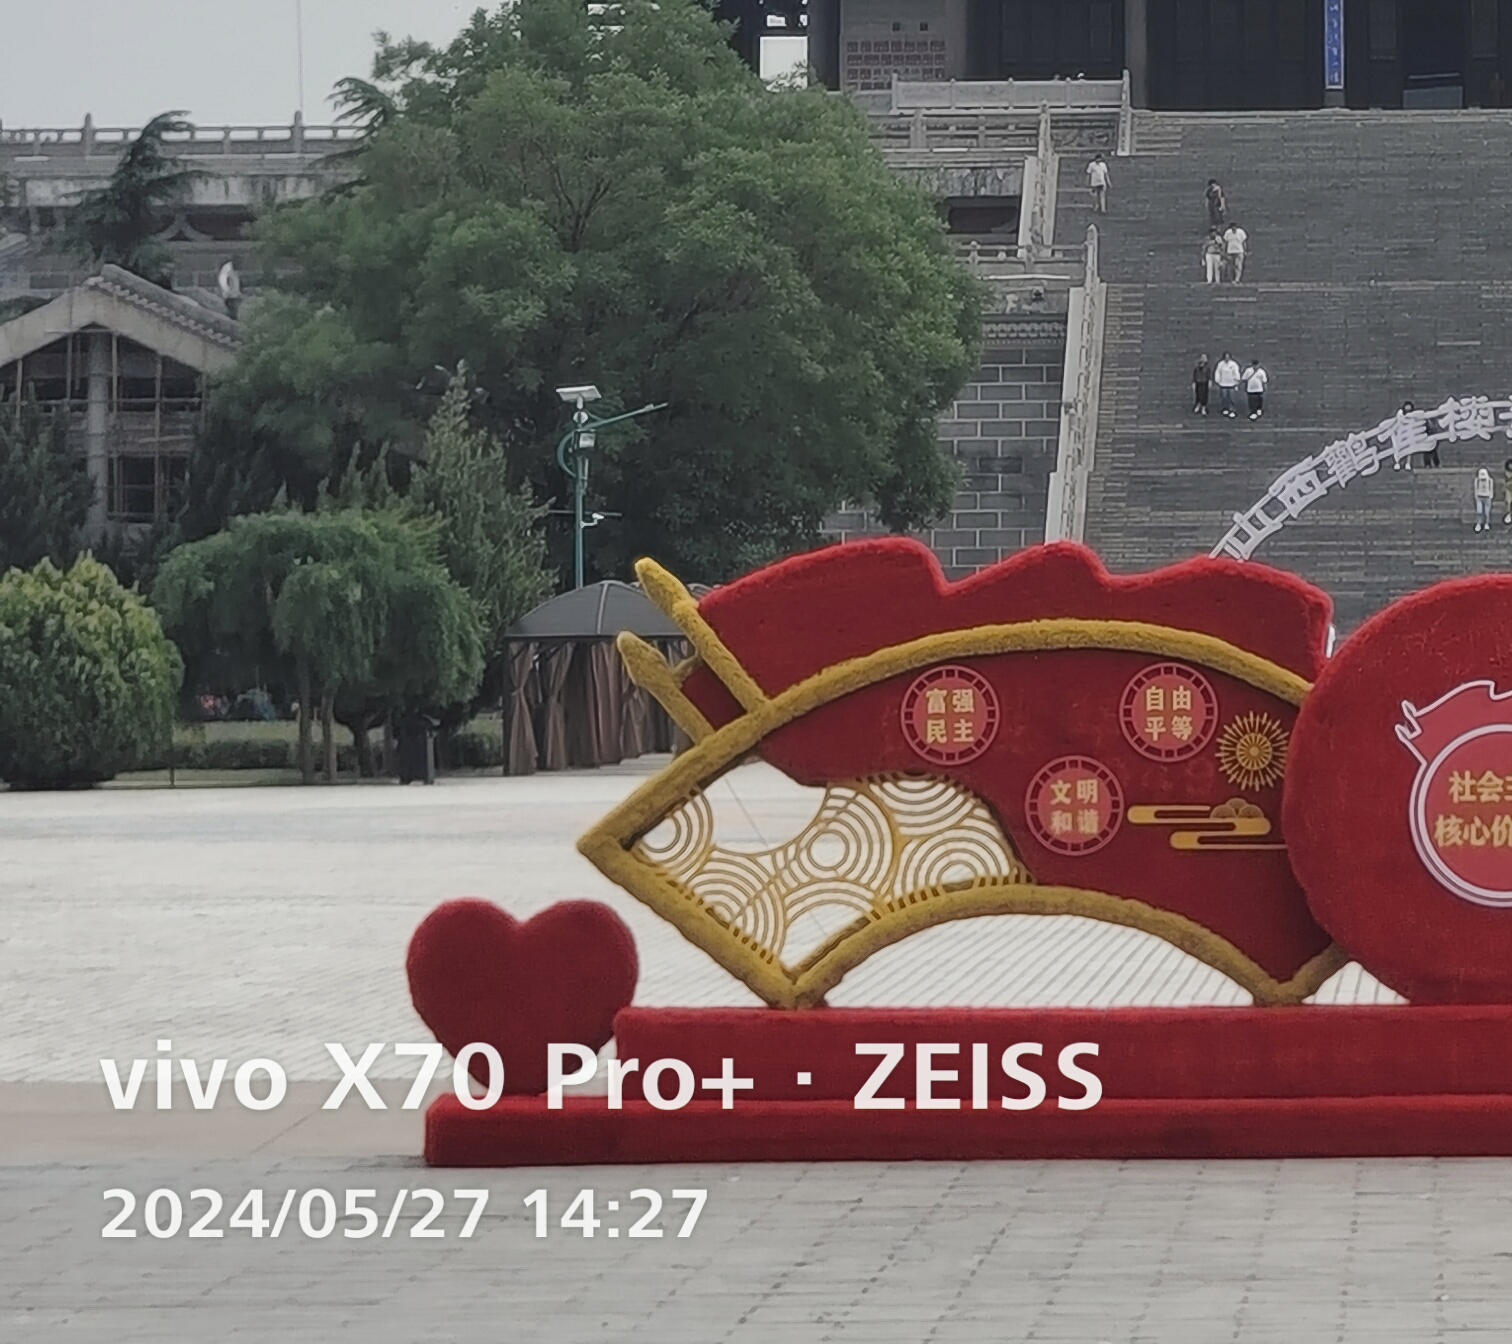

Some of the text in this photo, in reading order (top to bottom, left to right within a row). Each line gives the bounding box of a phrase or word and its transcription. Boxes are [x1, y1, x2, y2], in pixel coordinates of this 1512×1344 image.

[924, 687, 975, 715] 富强
[1144, 685, 1194, 712] 自由
[925, 718, 976, 745] 民主
[1144, 717, 1195, 743] 平等
[1050, 778, 1100, 806] 文明
[1050, 809, 1100, 836] 和谐
